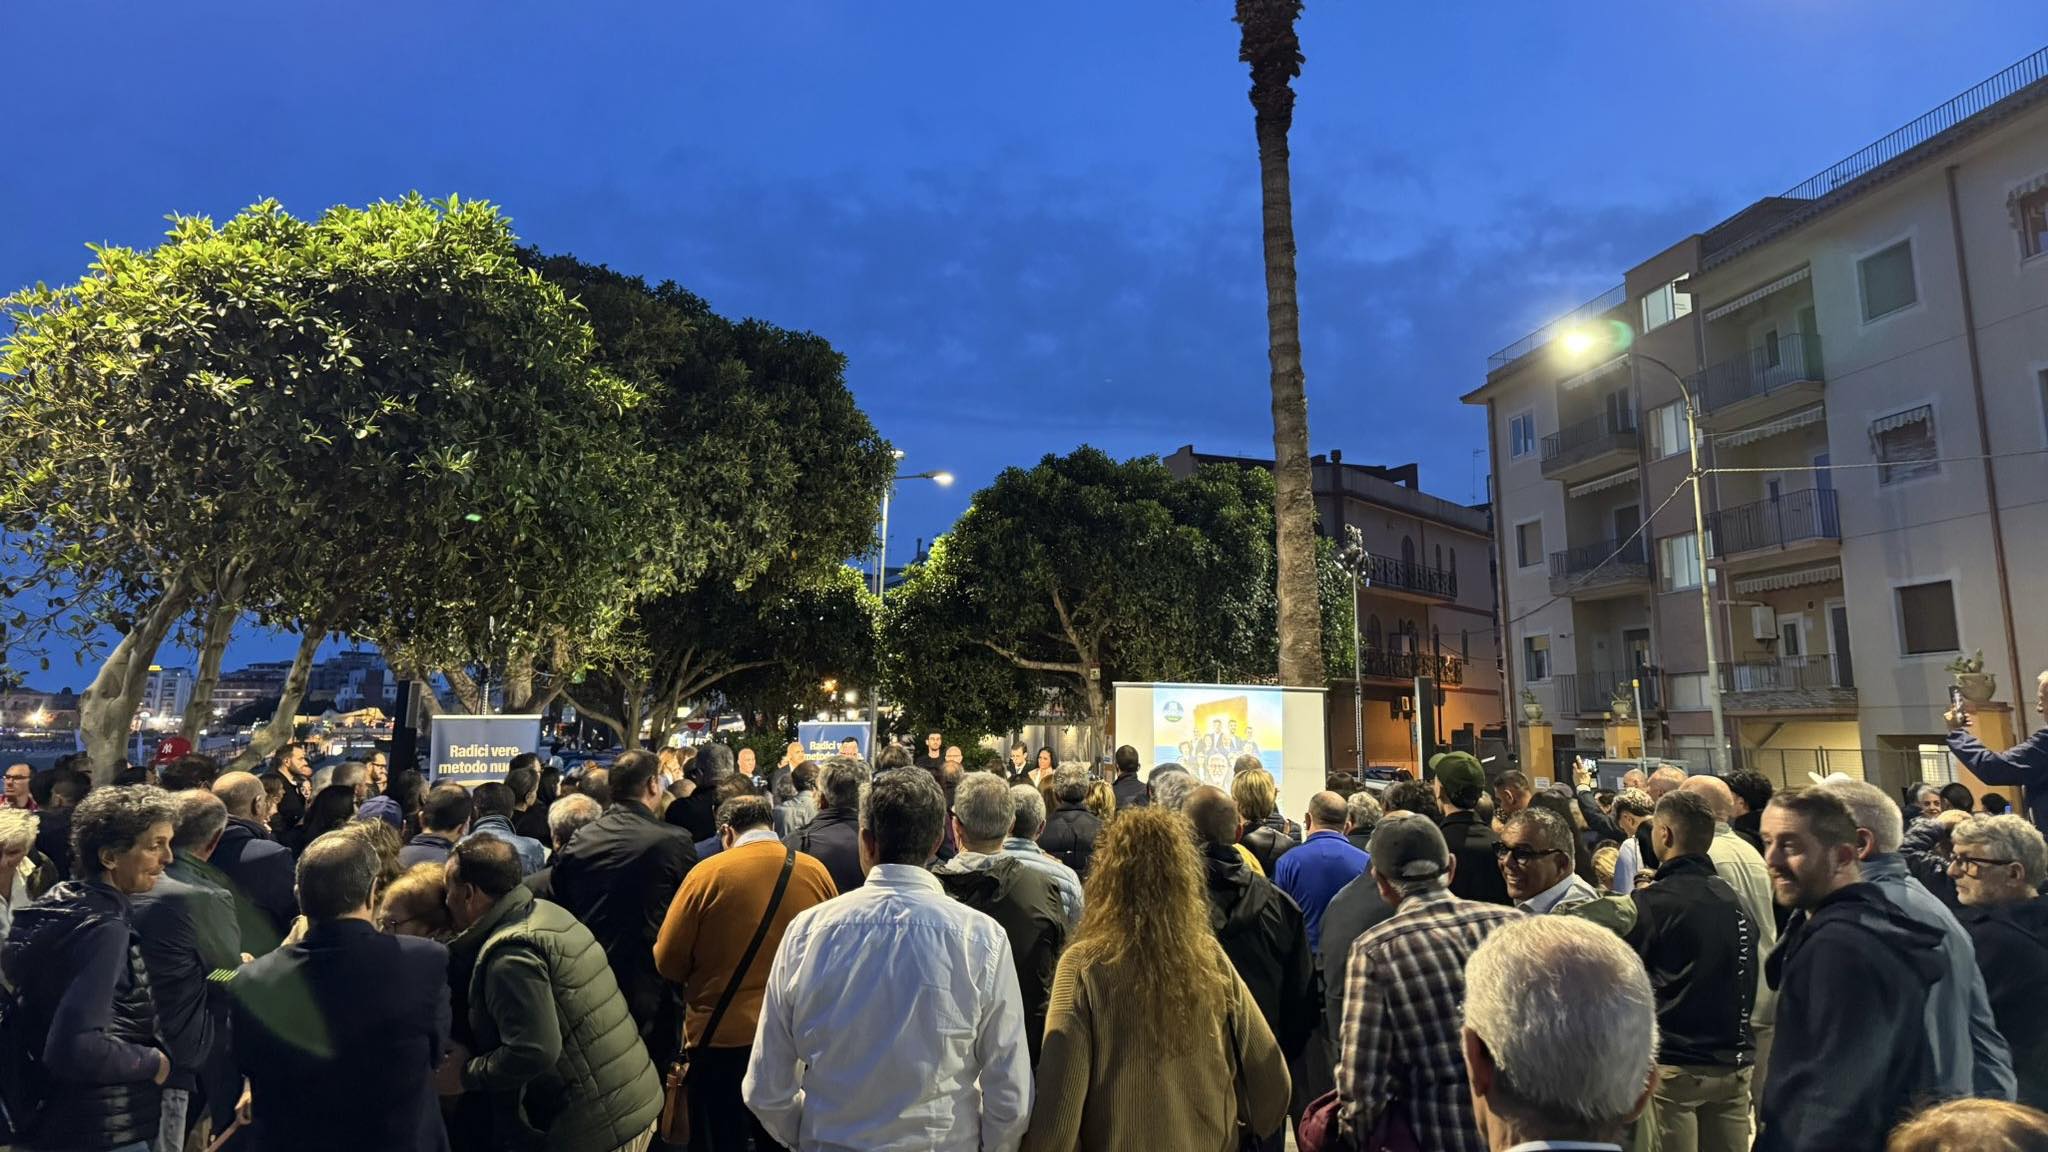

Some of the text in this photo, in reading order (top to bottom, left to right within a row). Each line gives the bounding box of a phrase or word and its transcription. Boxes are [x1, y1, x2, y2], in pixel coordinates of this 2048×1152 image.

[449, 744, 488, 758] Radici
[438, 760, 510, 773] metodo nu
